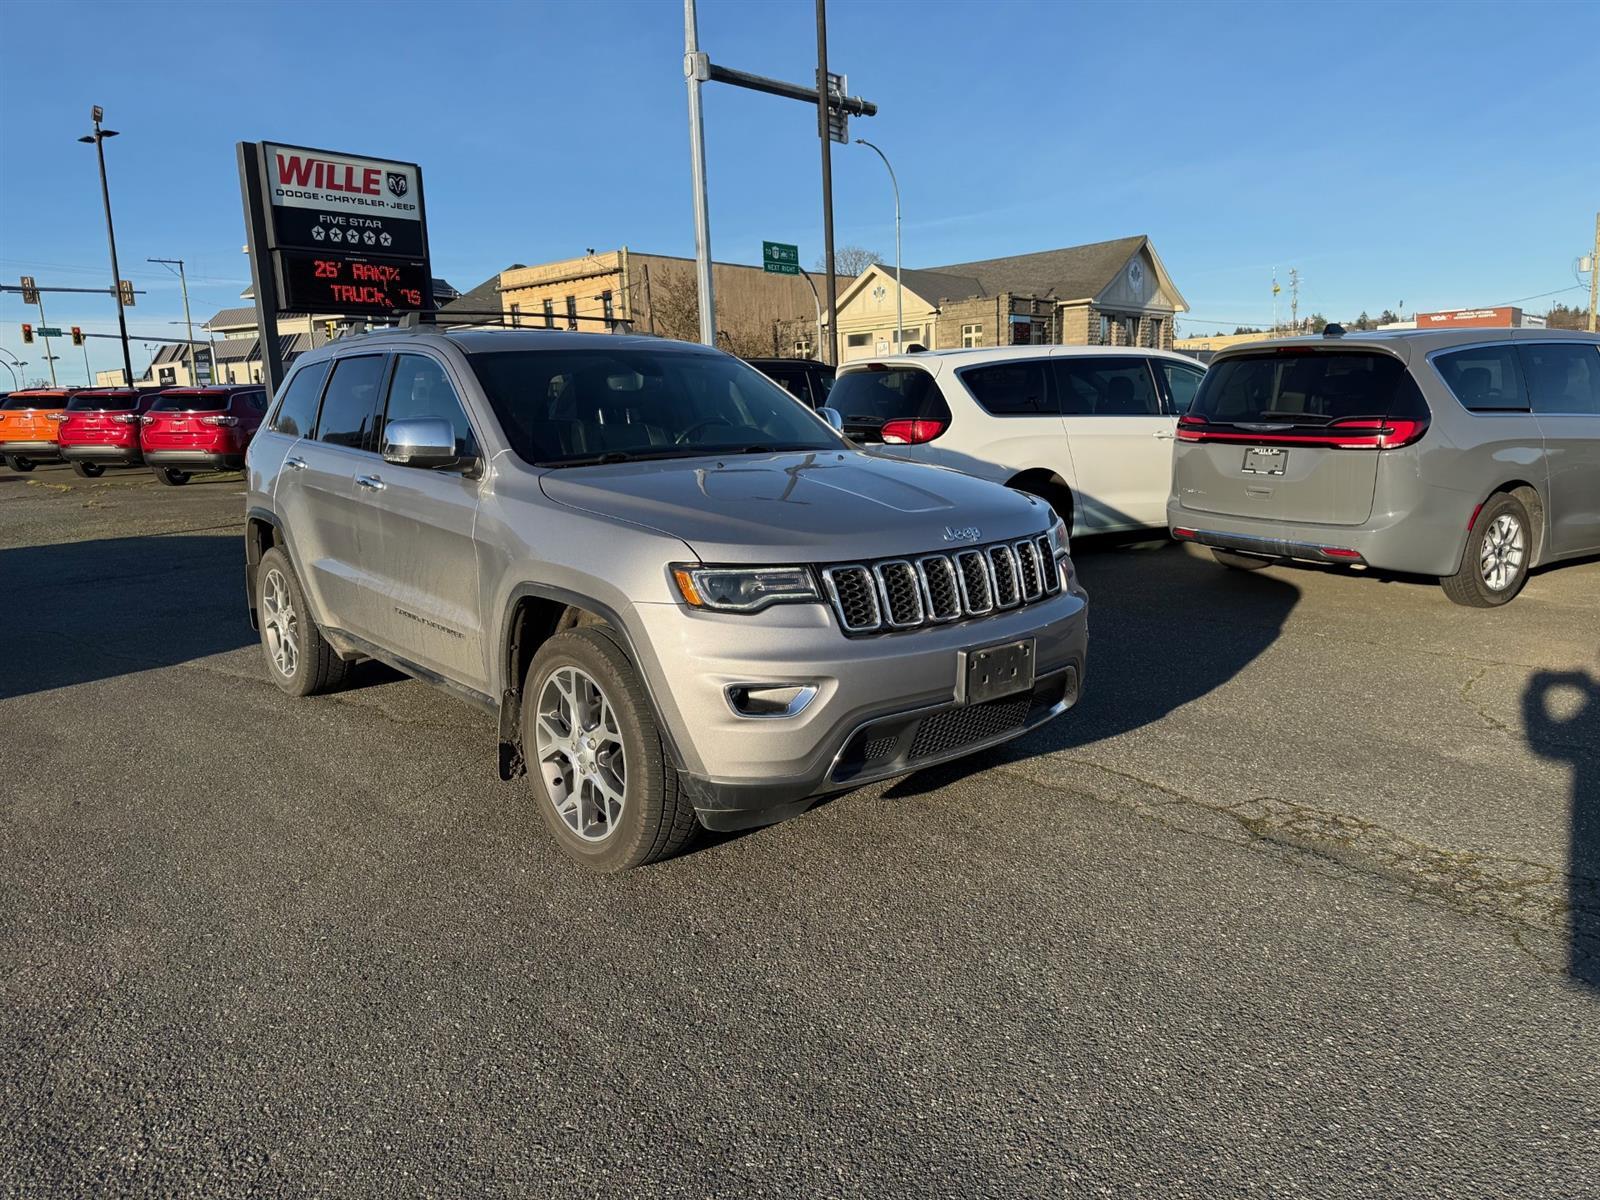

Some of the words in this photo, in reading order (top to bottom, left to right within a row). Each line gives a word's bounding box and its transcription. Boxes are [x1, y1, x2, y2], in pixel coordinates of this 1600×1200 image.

[276, 154, 381, 195] WILLE
[276, 189, 320, 200] DODGE
[325, 194, 385, 207] CHRYSLER
[390, 202, 416, 211] JEEP
[319, 215, 347, 225] FIVE
[349, 217, 382, 228] STAR
[943, 526, 981, 542] Jeep
